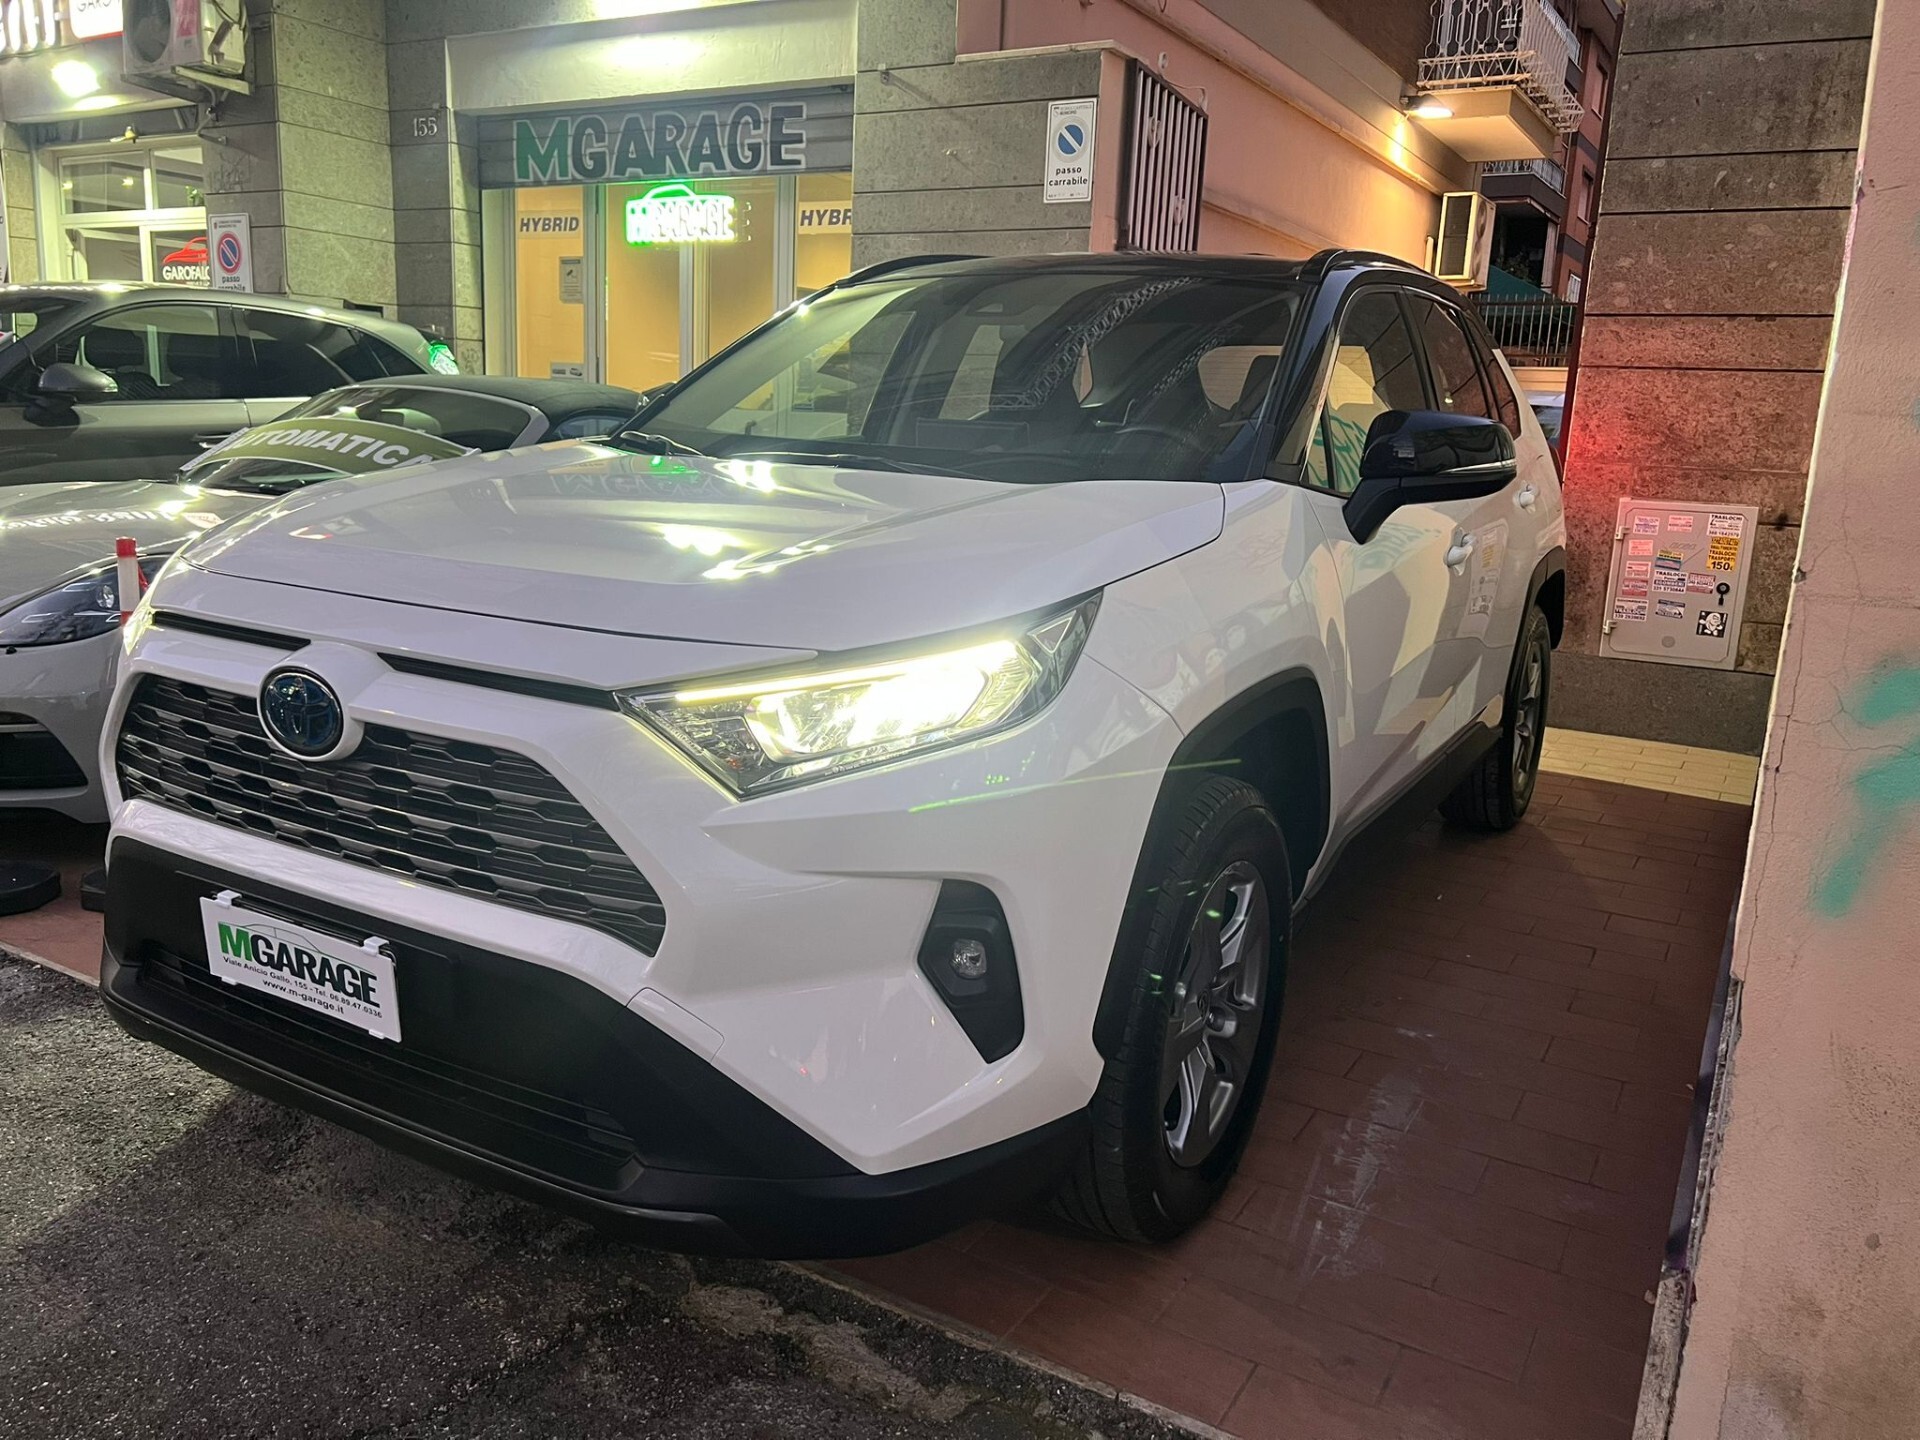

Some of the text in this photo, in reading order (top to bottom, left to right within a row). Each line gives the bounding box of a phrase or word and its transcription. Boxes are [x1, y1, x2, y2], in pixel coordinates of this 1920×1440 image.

[413, 116, 437, 137] 155
[513, 101, 808, 184] MGARAGE
[1048, 176, 1088, 186] carrabile
[1055, 166, 1082, 176] passo
[519, 216, 580, 232] HYBRID
[222, 276, 241, 284] passo
[217, 921, 381, 1009] MGARAGE
[223, 956, 242, 968] Viale
[244, 963, 268, 976] Anicio
[294, 980, 308, 990] 155
[262, 979, 345, 1014] www.m-garage.it
